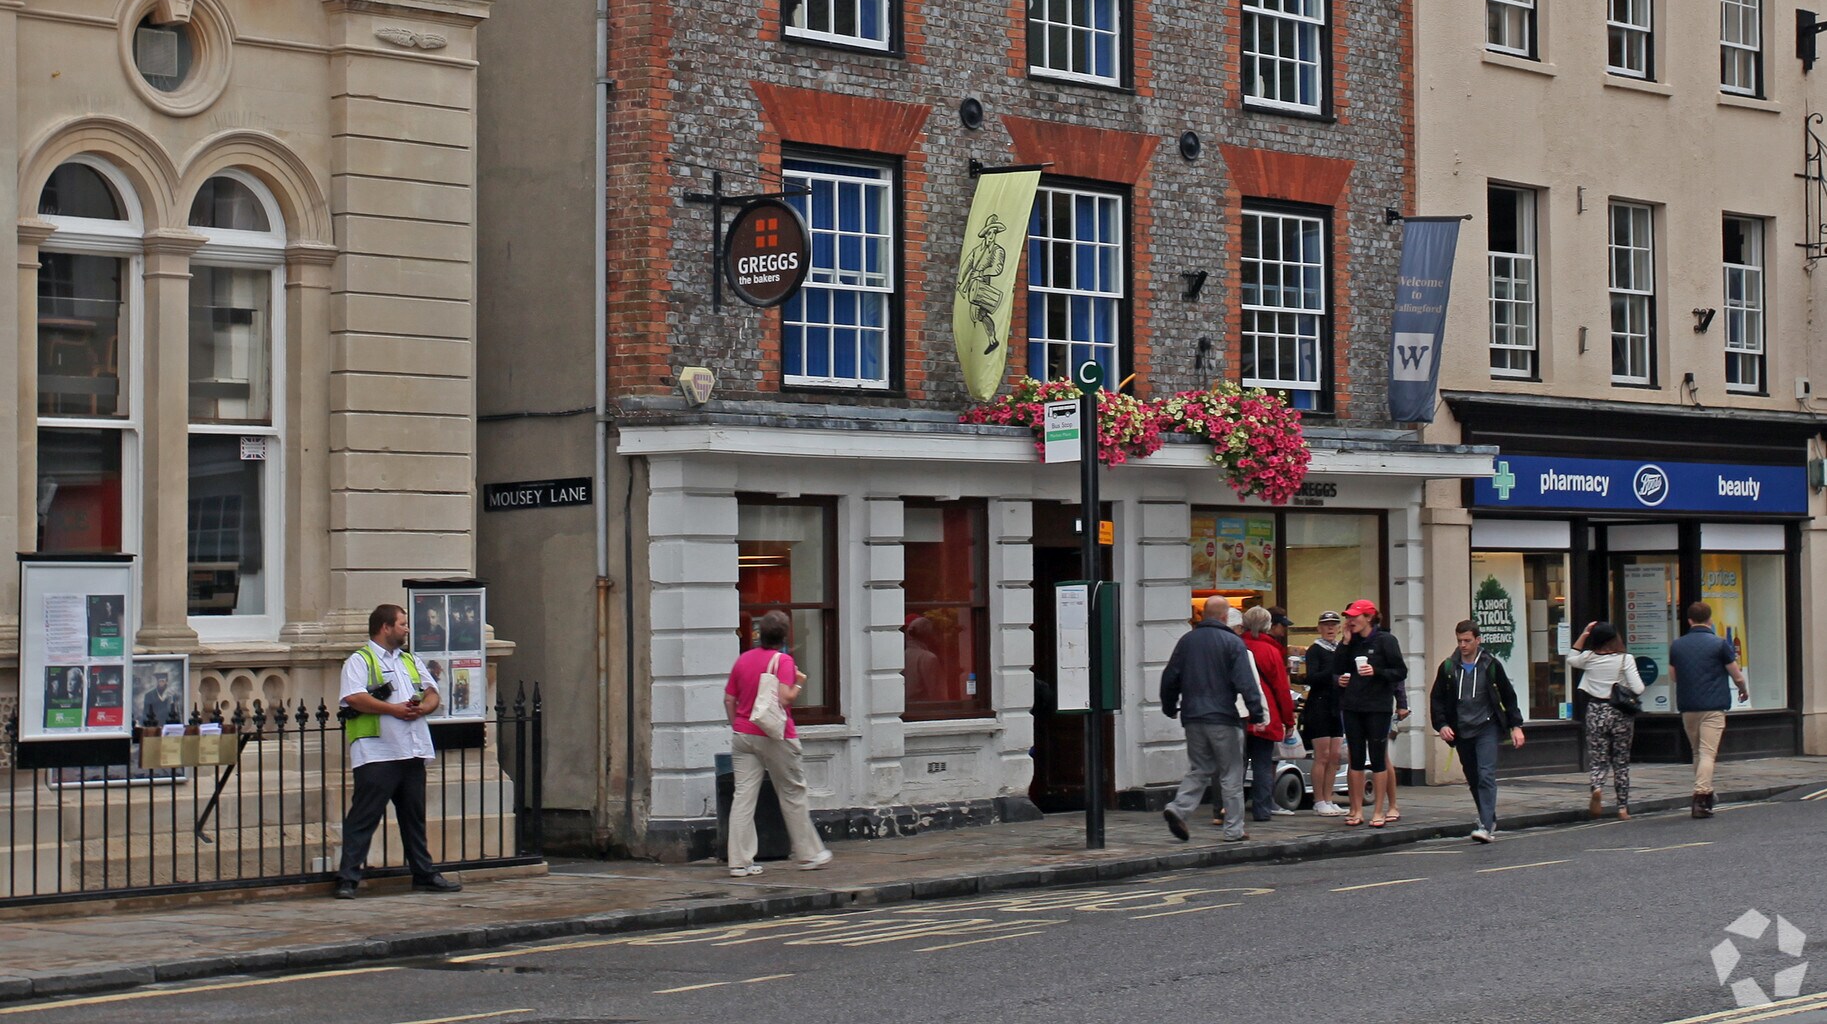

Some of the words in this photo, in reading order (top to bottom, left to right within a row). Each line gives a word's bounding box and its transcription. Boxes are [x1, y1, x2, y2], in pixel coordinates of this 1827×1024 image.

[738, 252, 799, 274] GREGGS
[739, 275, 752, 285] the
[753, 274, 781, 284] bakers
[1412, 290, 1422, 299] to
[1395, 304, 1442, 314] allingford
[1397, 345, 1430, 370] W
[1080, 361, 1097, 383] C
[1061, 421, 1072, 429] Stop
[1541, 469, 1609, 496] pharmacy
[1718, 475, 1760, 501] beauty
[489, 489, 542, 507] MOUSEY
[550, 487, 587, 503] LANE
[1708, 571, 1736, 589] price
[1478, 600, 1484, 610] A
[1485, 599, 1507, 610] SHORT
[1477, 610, 1511, 625] STROLL
